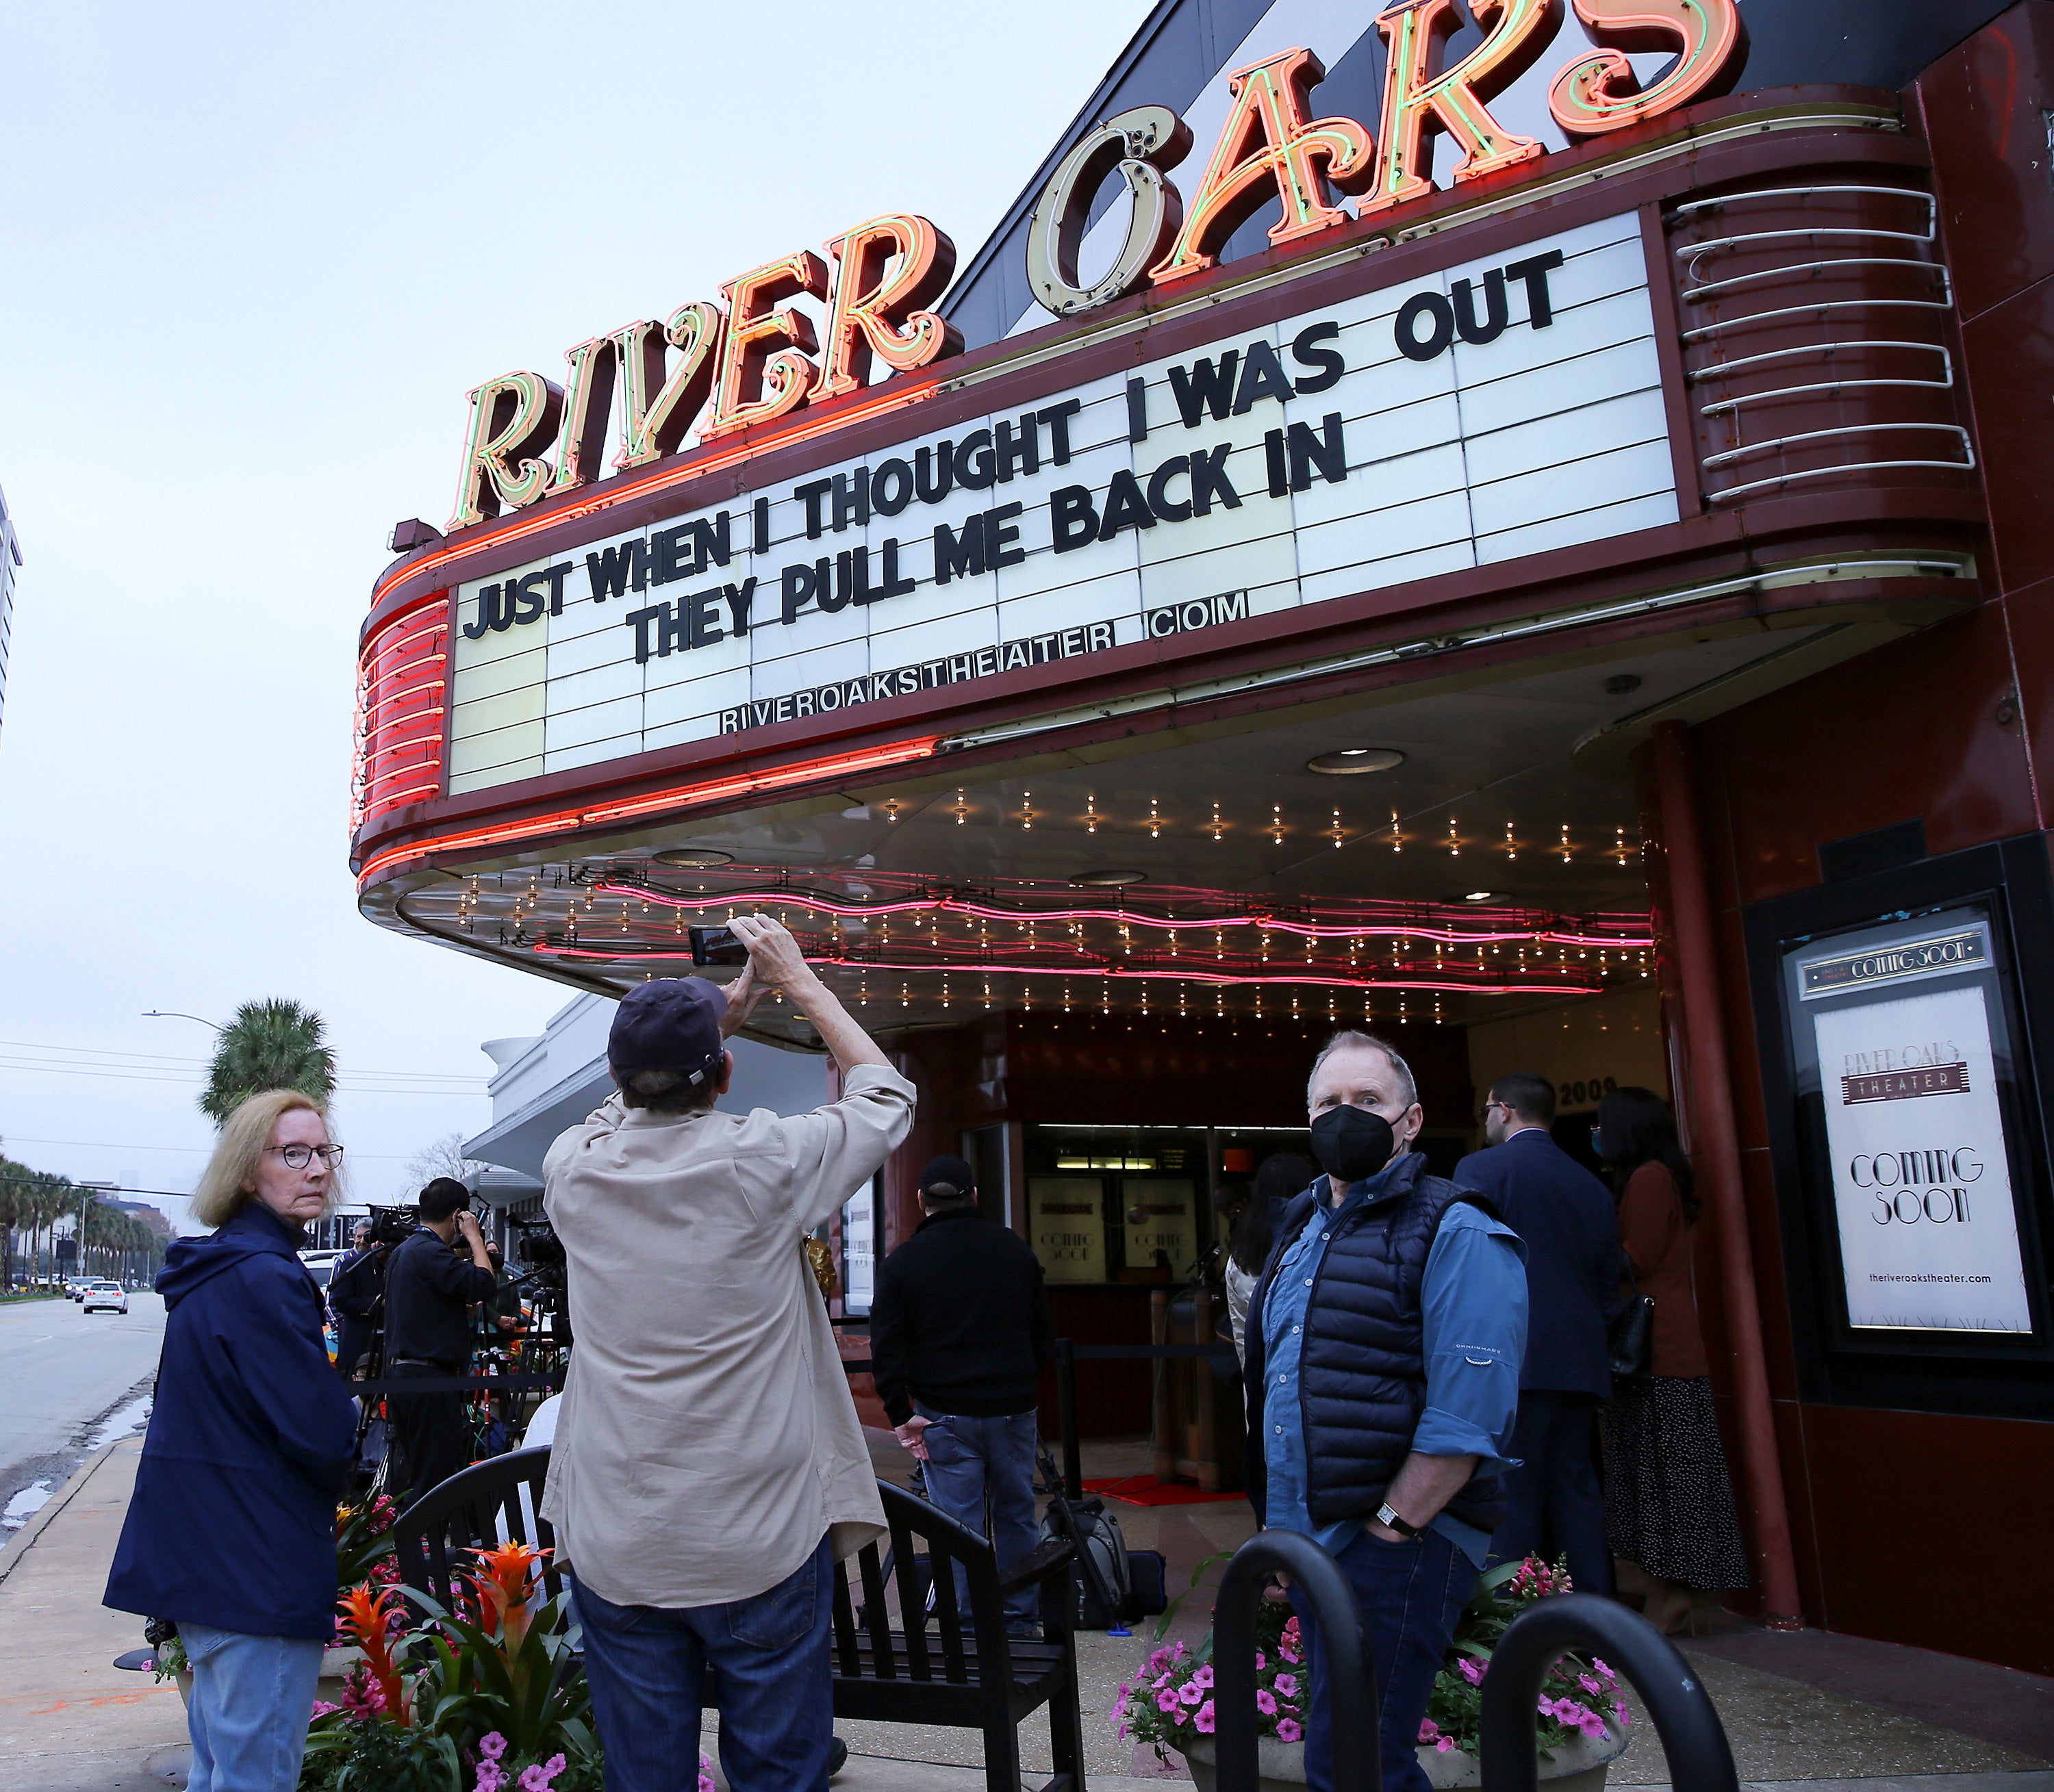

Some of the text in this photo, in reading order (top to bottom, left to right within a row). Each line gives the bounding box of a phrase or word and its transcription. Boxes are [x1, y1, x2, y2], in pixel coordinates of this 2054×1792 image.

[445, 0, 1749, 531] RIVER OAKS
[463, 248, 1563, 639] JUST WHEN I THOUGHT I WAS OUT
[626, 412, 1347, 664] THEY PULL ME BACK IN
[722, 592, 1247, 735] RIVEROAKSTHEATER COM
[1851, 951, 1914, 978] COMING
[1916, 942, 1966, 967] SOON
[1844, 1040, 1959, 1075] RIVER OAKS
[1560, 1076, 1617, 1105] 2009
[1858, 1073, 1949, 1095] THEATER
[1851, 1147, 1983, 1188] COMING
[1871, 1188, 1970, 1225] SOON
[1870, 1273, 1991, 1283] theriveroakstheater.com
